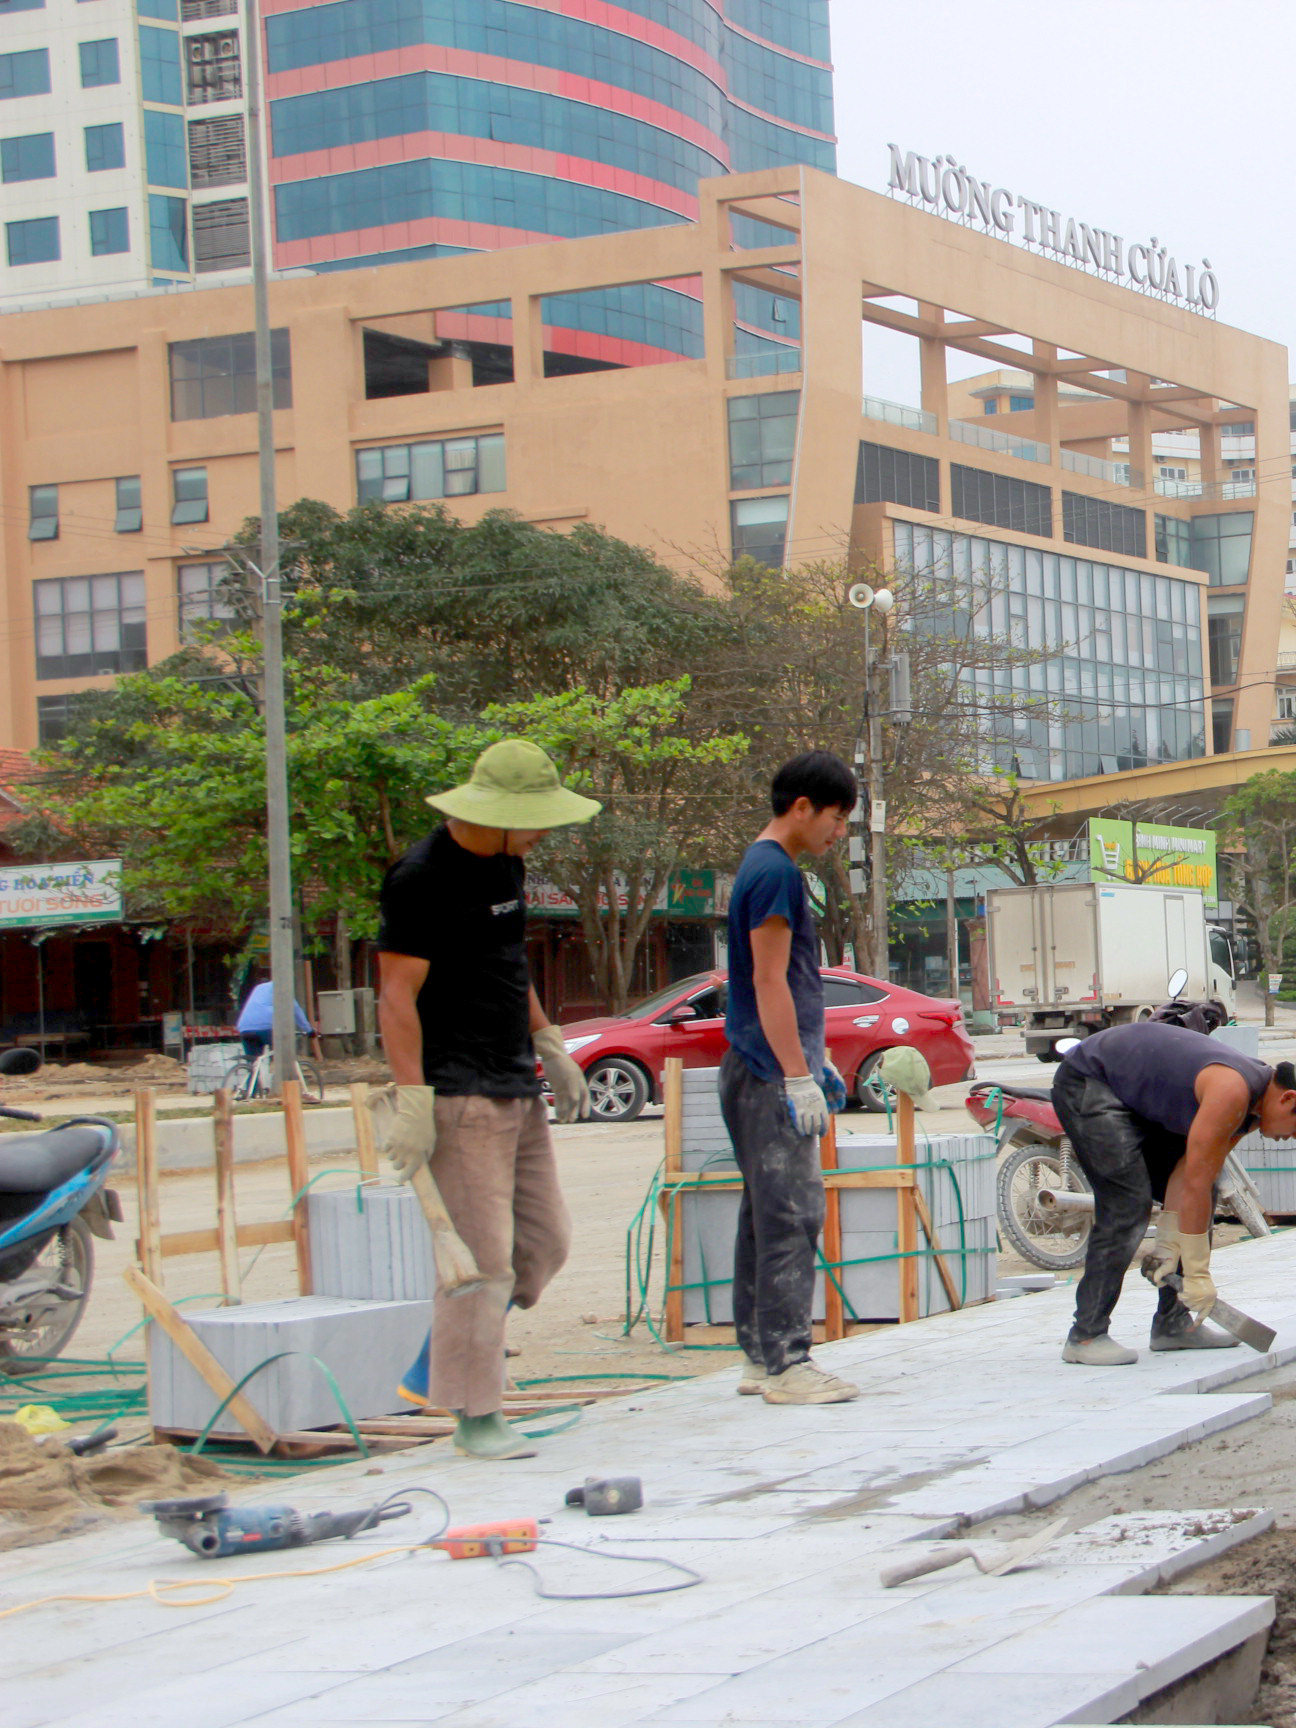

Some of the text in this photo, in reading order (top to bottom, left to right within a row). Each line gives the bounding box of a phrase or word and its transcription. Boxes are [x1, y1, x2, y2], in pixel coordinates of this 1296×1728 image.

[887, 143, 1220, 310] MƯỜNG THANH CỬA LÒ
[1171, 837, 1207, 854] MINIMART
